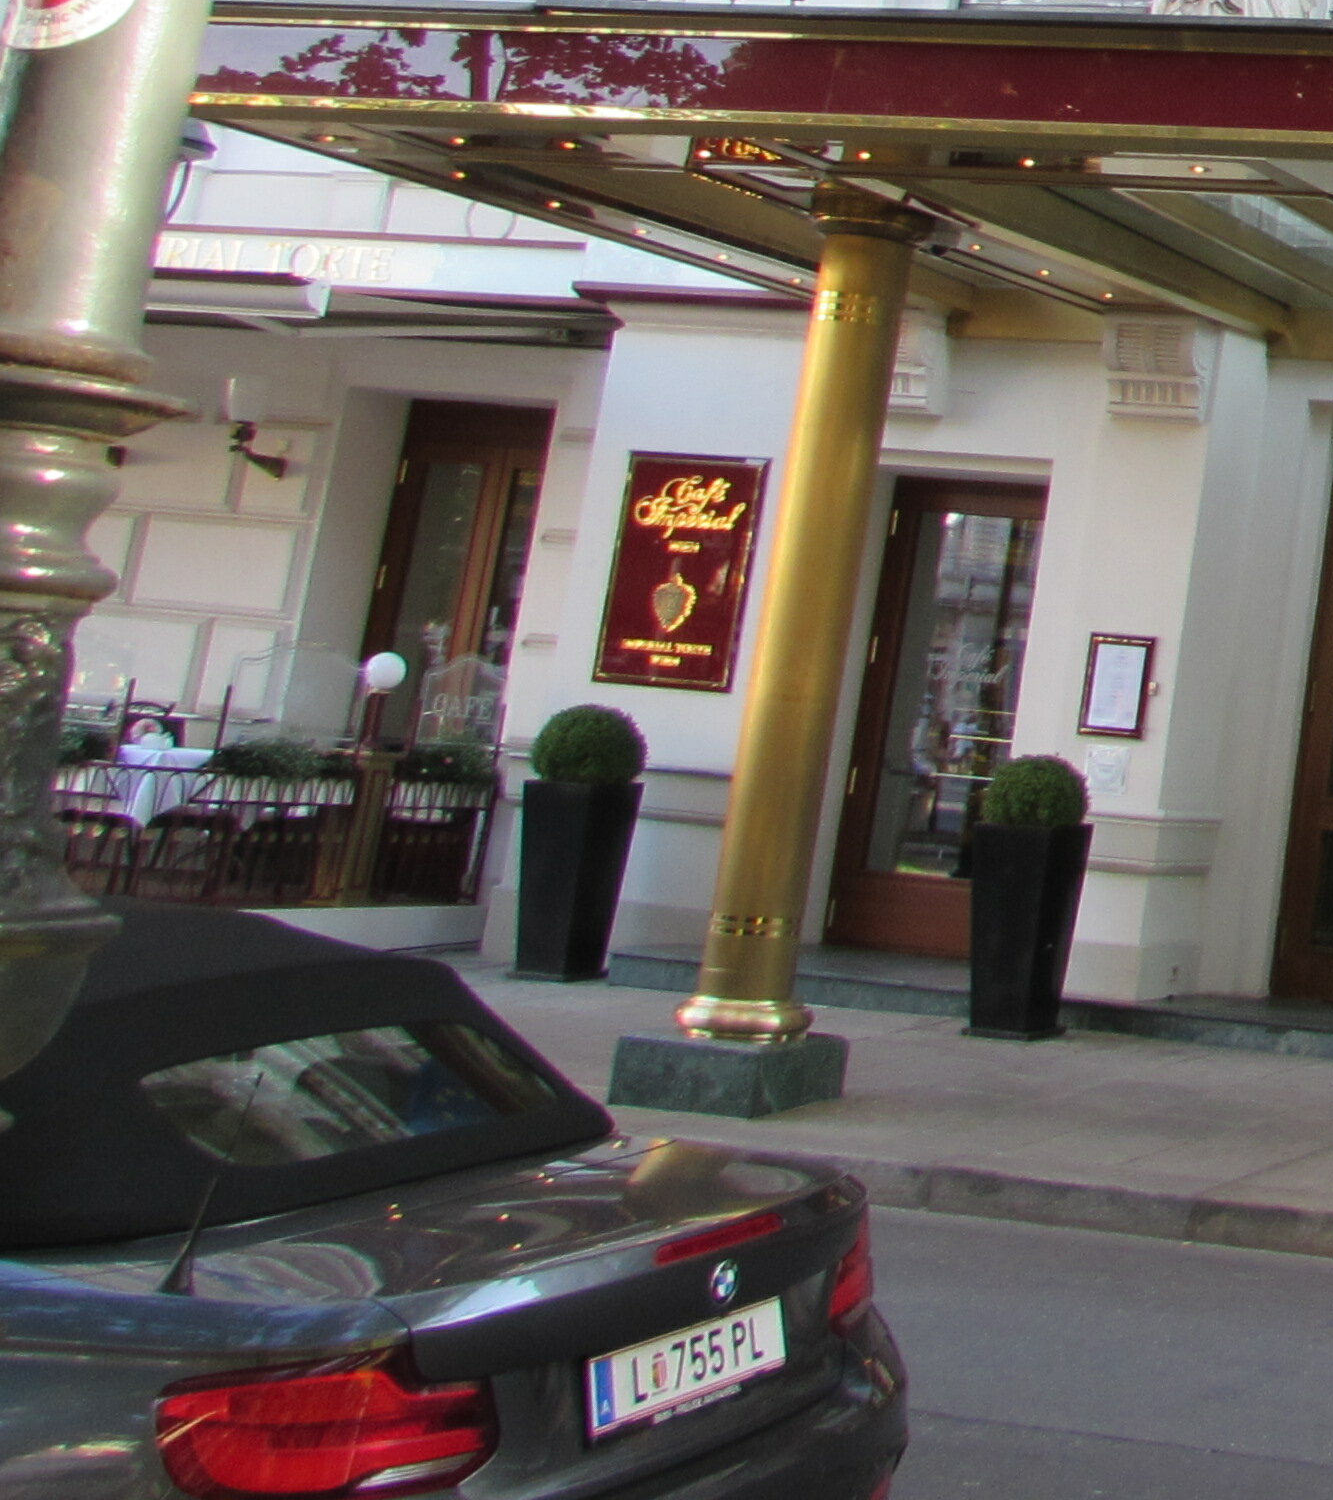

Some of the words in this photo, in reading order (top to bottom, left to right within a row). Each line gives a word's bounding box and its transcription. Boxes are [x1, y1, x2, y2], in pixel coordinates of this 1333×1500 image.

[160, 236, 247, 272] RIAL
[267, 240, 395, 283] TORTE
[661, 475, 732, 512] Café
[634, 495, 748, 539] Imperial
[632, 1357, 648, 1404] L
[670, 1328, 725, 1390] 755
[731, 1317, 764, 1367] PL
